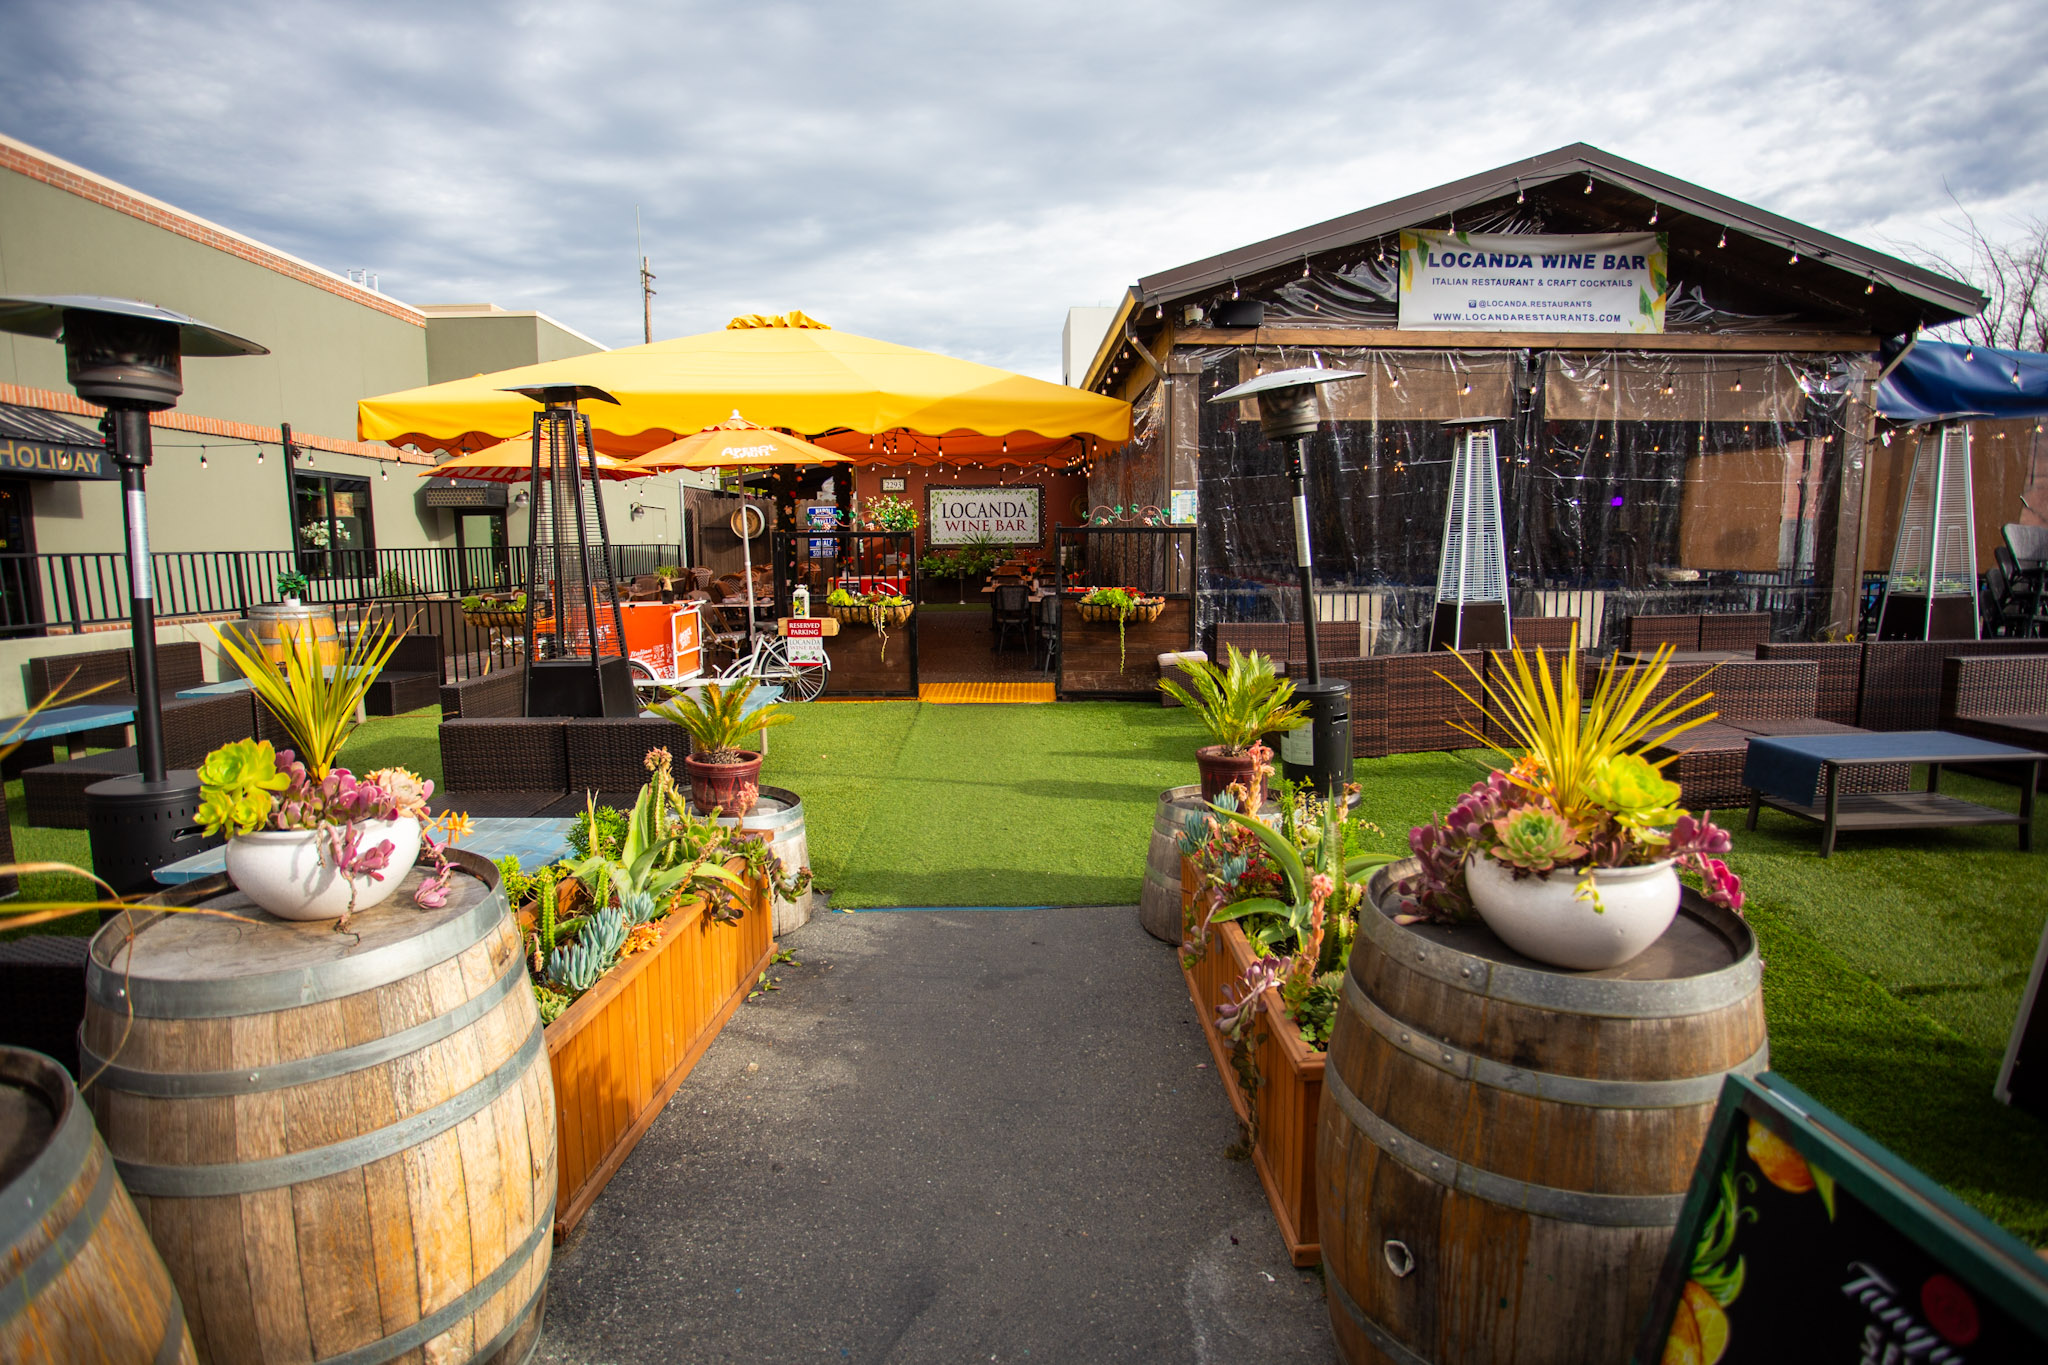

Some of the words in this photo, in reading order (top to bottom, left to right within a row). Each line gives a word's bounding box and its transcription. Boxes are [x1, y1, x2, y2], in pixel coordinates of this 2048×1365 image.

[1428, 252, 1533, 269] LOCANDA
[1541, 254, 1596, 269] WINE
[1603, 255, 1647, 270] BAR
[1432, 277, 1468, 287] ITALIAN
[1471, 278, 1536, 287] RESTAURANT
[1537, 278, 1544, 287] &
[1546, 279, 1577, 287] CRAFT
[1579, 279, 1633, 287] COCKTAILS
[1478, 300, 1593, 309] @LOCANDA.RESTAURANTS
[1433, 312, 1621, 323] WWW.LOCANDARESTAURANTS.COM
[885, 481, 902, 489] 2293
[942, 501, 1029, 518] LOCANDA
[945, 519, 990, 532] WINE
[995, 519, 1027, 532] BAR
